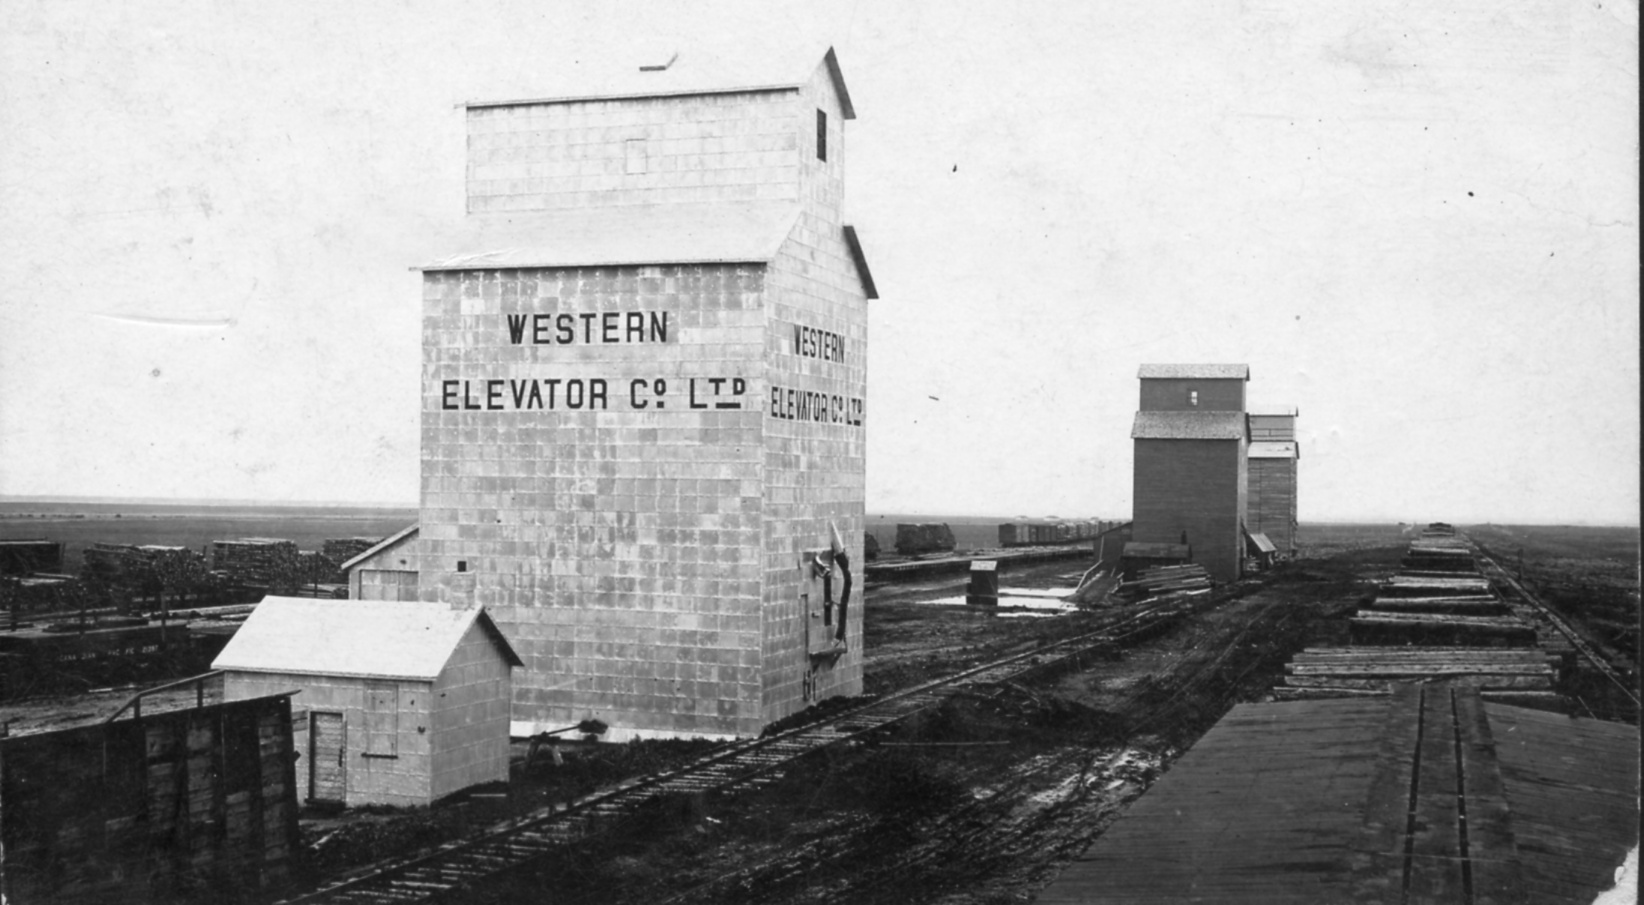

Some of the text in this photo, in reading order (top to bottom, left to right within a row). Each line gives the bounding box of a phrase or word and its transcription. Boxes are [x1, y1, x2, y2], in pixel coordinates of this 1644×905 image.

[507, 311, 667, 344] WESTERN
[794, 324, 845, 364] WESTERN
[442, 378, 608, 410] ELEVATOR
[690, 378, 745, 409] LTD
[771, 386, 828, 423] ELEVATOR
